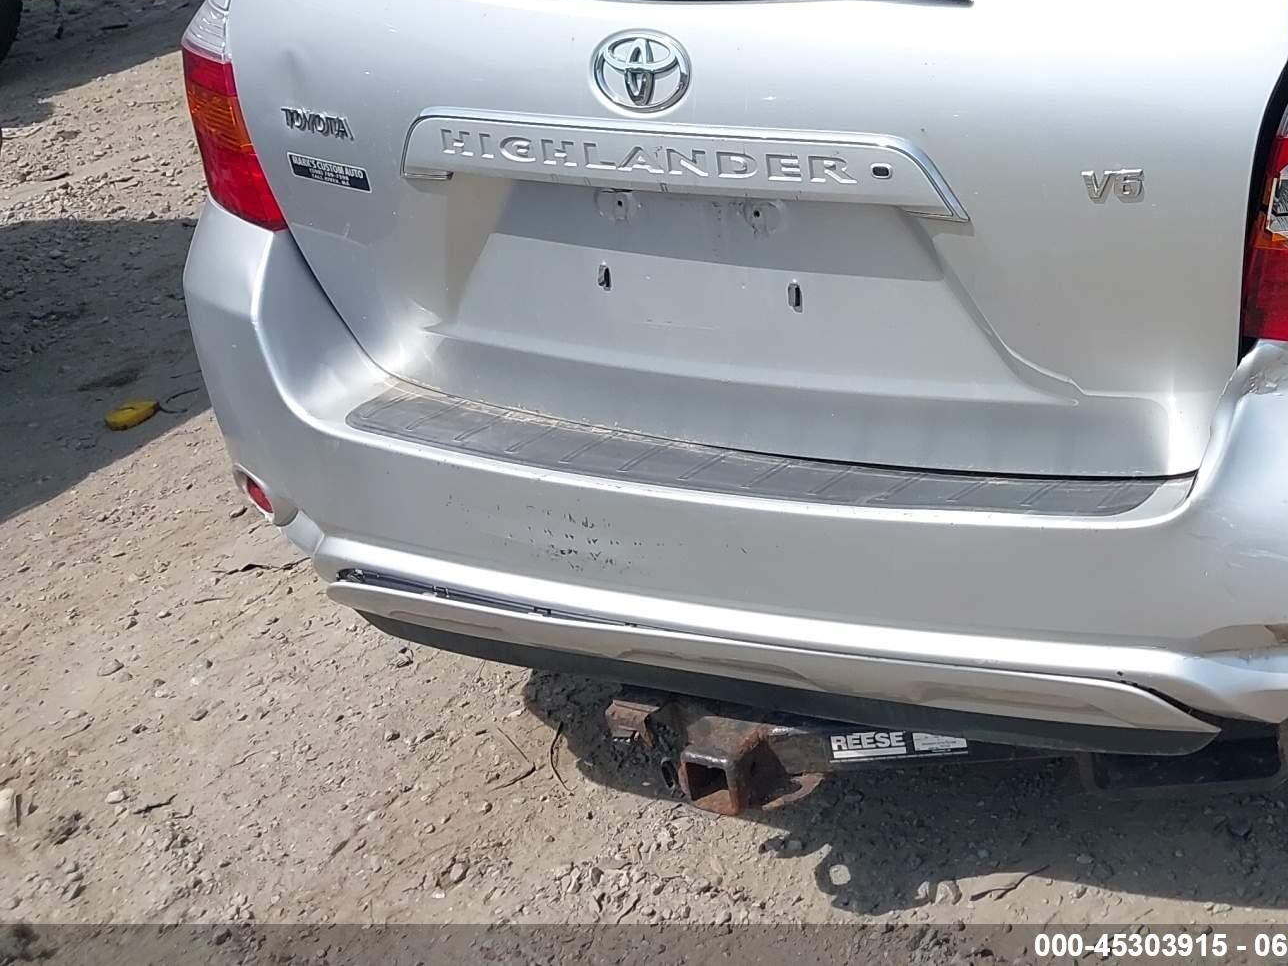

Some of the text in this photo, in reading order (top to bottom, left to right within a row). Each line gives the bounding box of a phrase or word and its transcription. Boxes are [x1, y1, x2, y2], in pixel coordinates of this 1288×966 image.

[281, 106, 354, 141] TOYOTA
[316, 161, 343, 175] CUSTOM
[345, 166, 364, 179] AUTO
[440, 128, 858, 185] HIGHLANDER
[1080, 169, 1144, 204] V6
[830, 731, 906, 751] REESE
